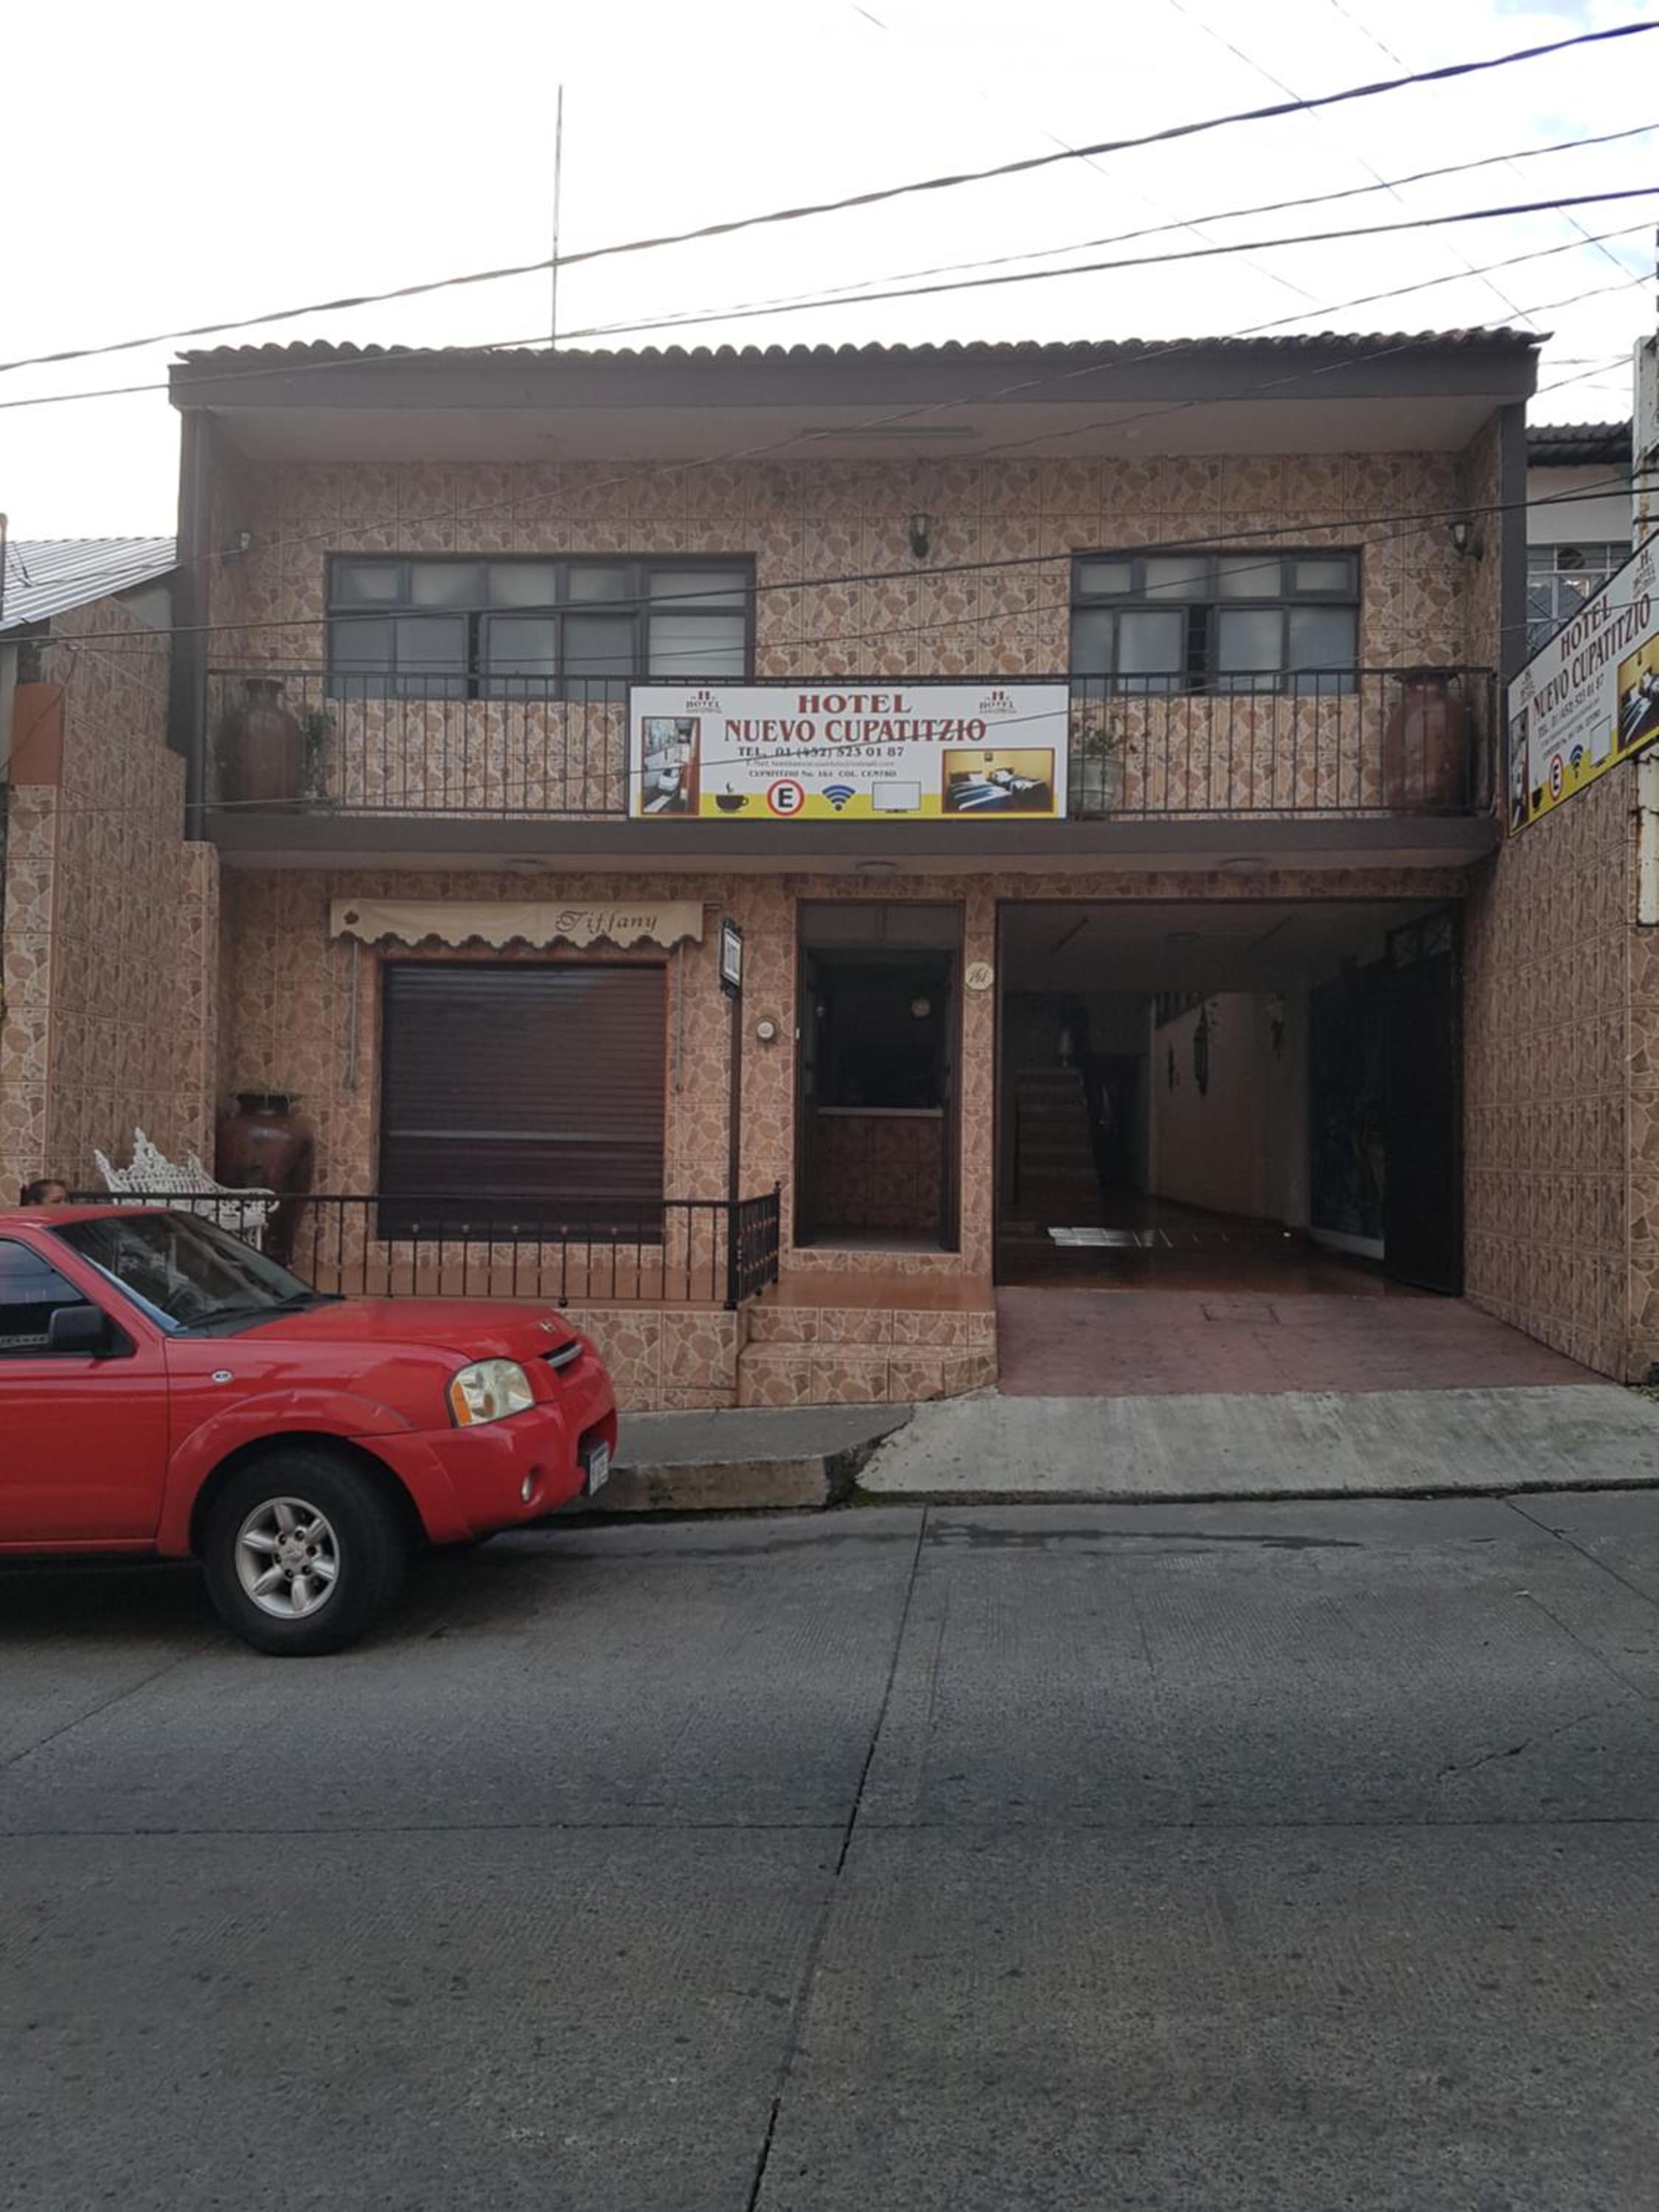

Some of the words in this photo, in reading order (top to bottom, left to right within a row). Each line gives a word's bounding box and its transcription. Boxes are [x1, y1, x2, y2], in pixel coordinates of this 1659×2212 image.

[1560, 593, 1612, 662] HOTEL
[1571, 593, 1651, 689] CUPATITZIO
[799, 694, 912, 714] HOTEL
[725, 720, 816, 742] NUEVO
[824, 718, 987, 742] CUPATITZIO
[775, 746, 792, 757] 01
[837, 746, 861, 757] 523
[865, 746, 882, 757] 01
[887, 745, 905, 757] 87
[777, 787, 794, 809] E
[554, 910, 658, 935] Tiffany
